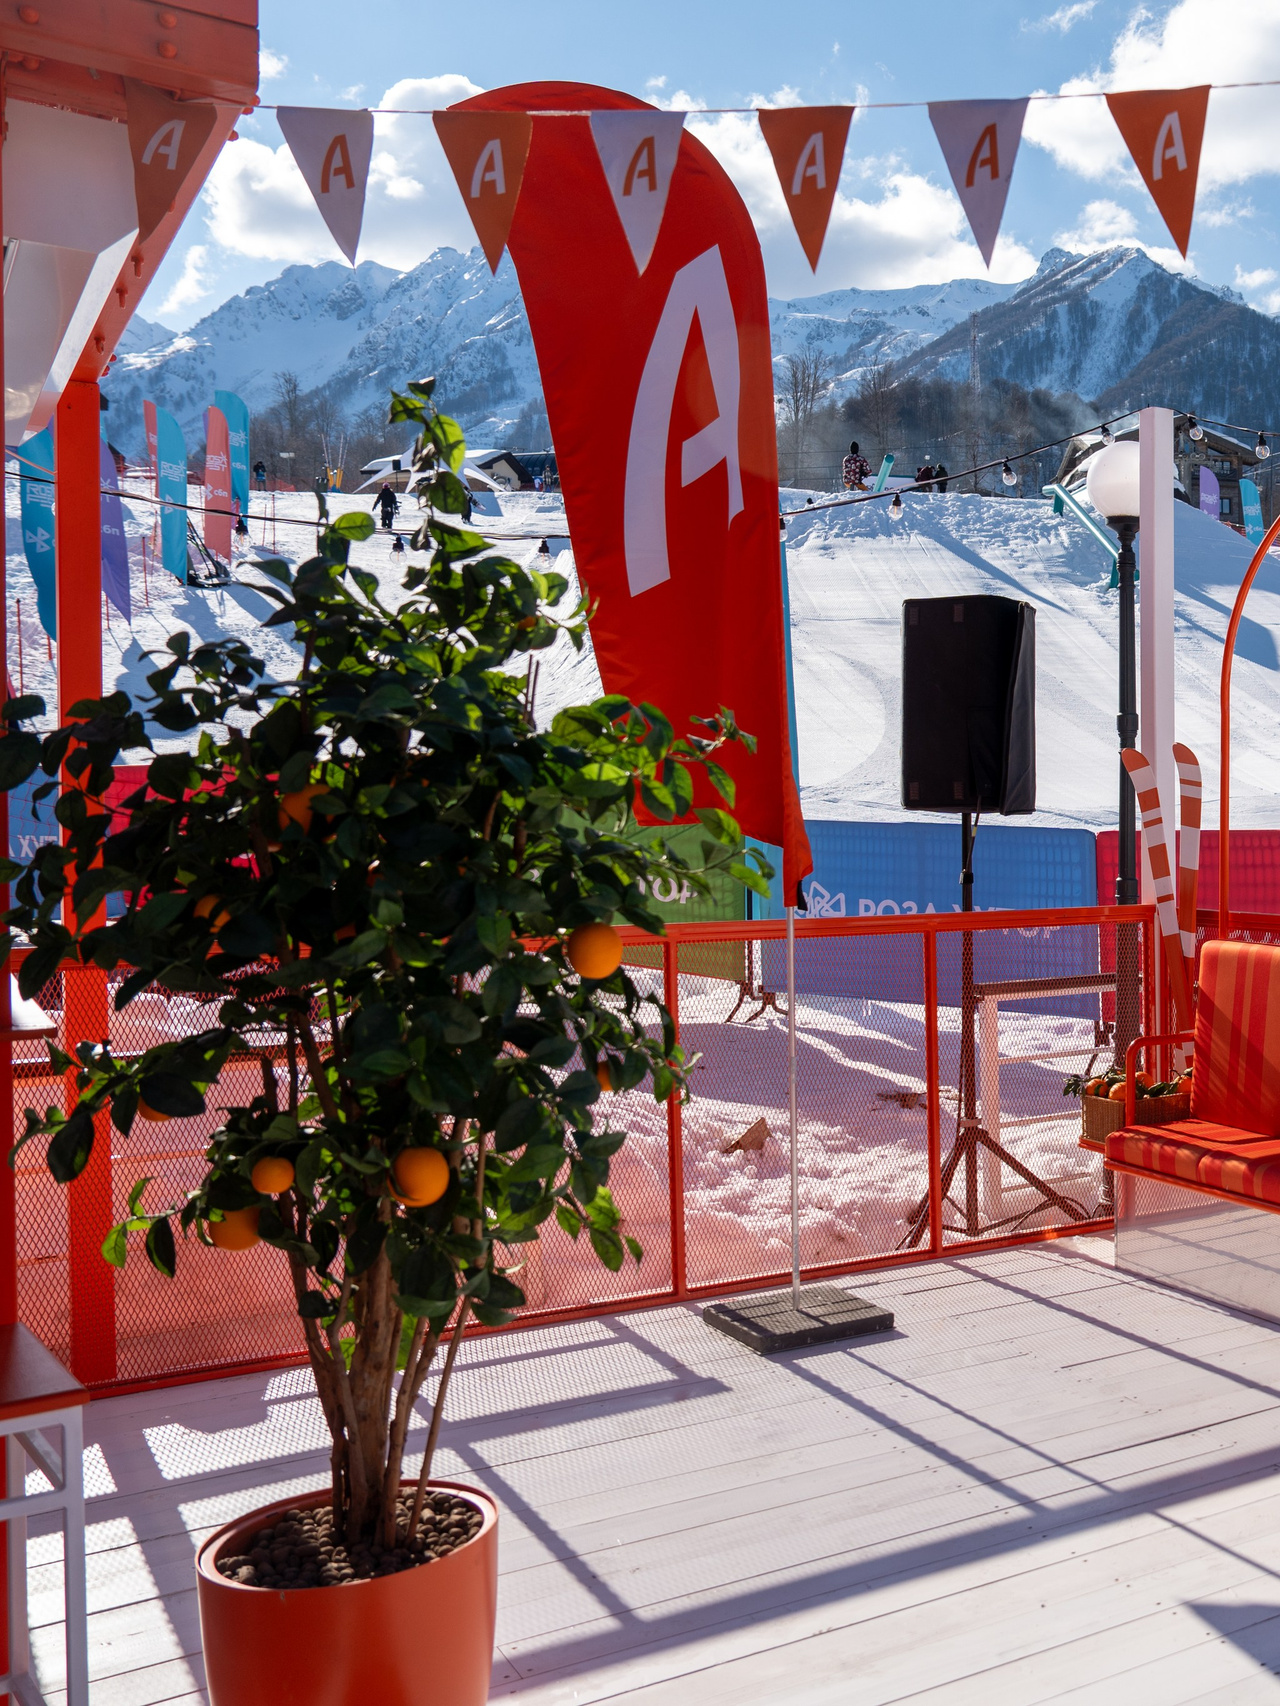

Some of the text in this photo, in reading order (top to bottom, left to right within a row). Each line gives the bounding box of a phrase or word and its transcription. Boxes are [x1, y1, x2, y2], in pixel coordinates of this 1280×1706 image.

[140, 119, 186, 170] A
[320, 133, 355, 194] A
[470, 138, 505, 197] A
[623, 136, 657, 197] A
[791, 132, 826, 195] A
[964, 122, 1000, 188] A
[1152, 111, 1188, 180] A
[624, 243, 744, 598] A
[101, 525, 120, 536] бп
